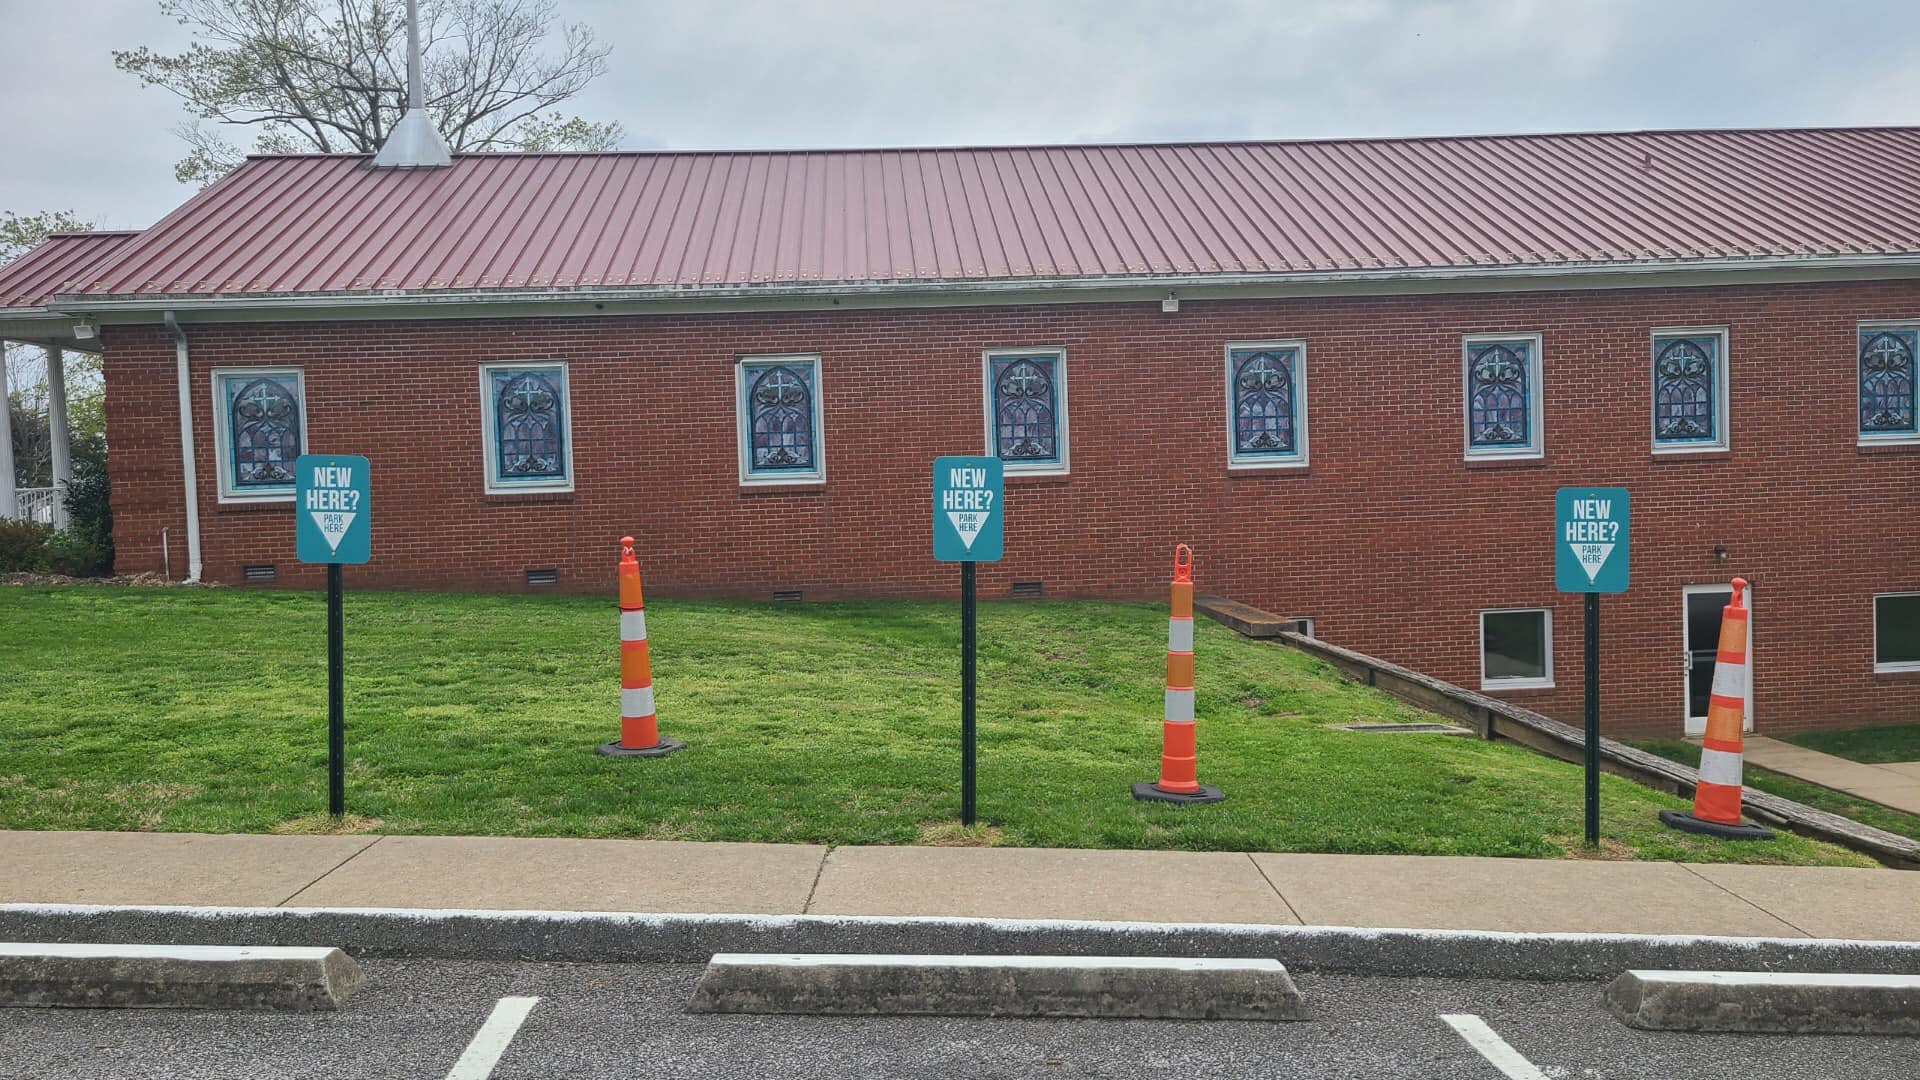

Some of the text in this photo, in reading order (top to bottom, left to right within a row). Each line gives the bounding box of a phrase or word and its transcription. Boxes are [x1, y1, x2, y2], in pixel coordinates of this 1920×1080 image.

[314, 466, 352, 488] NEW
[950, 468, 986, 488] NEW
[306, 489, 360, 510] HERE?
[943, 489, 994, 510] HERE?
[1573, 499, 1611, 520] NEW
[323, 513, 344, 524] PARK
[958, 513, 978, 523] PARK
[323, 523, 344, 533] HERE
[959, 522, 978, 532] HERE
[1565, 521, 1619, 542] HERE?
[1582, 545, 1602, 554] PARK
[1582, 554, 1602, 564] HERE
